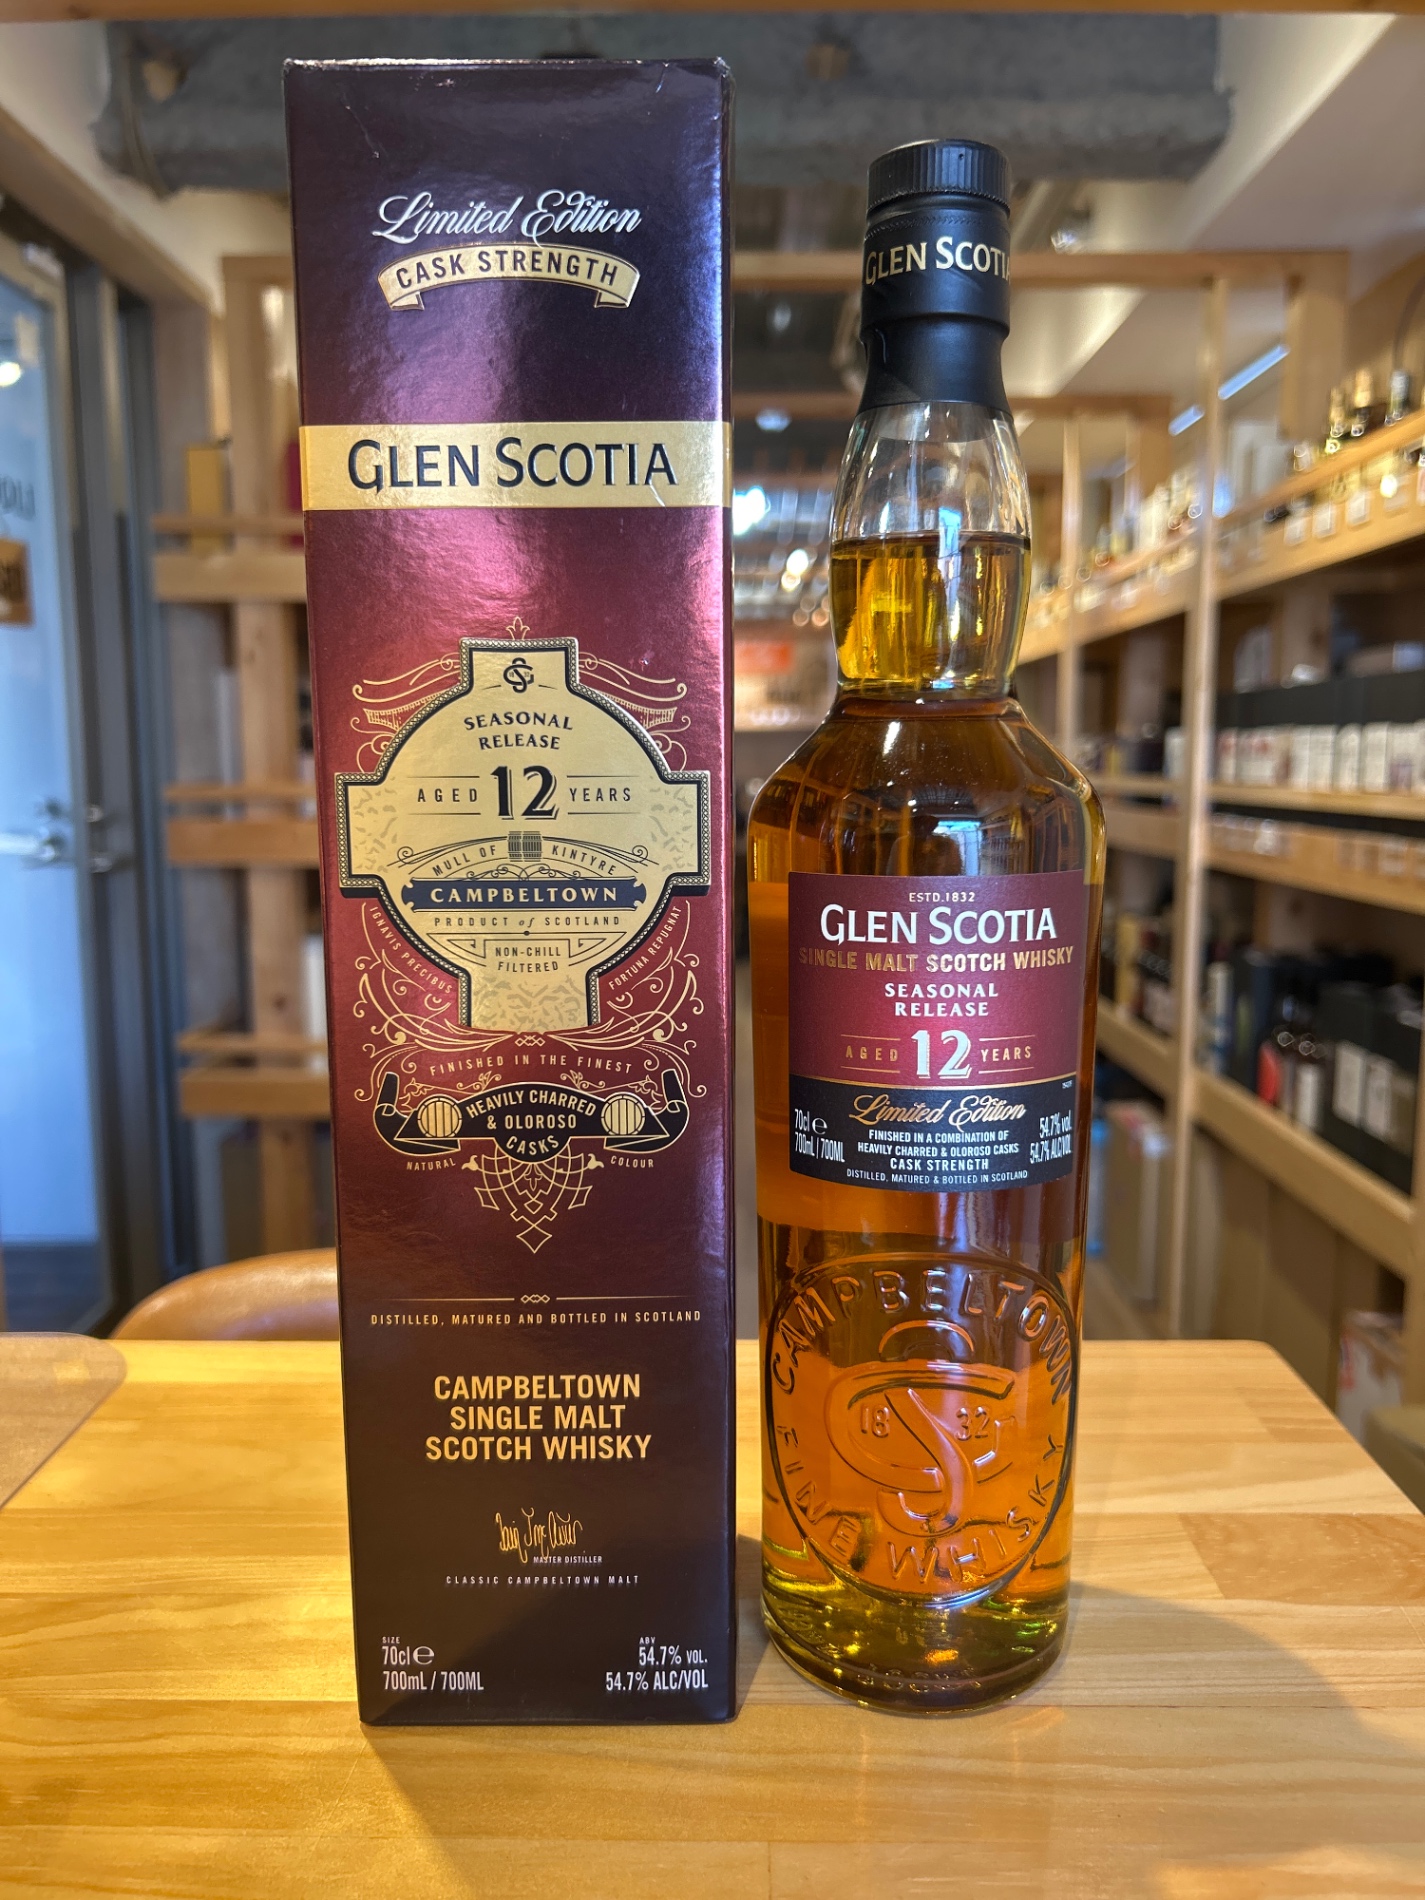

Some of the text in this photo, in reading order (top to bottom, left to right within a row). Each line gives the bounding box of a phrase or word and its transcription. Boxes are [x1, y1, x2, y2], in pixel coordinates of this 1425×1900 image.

[372, 189, 642, 248] Limited Edition
[396, 250, 618, 289] CASK STRENGTH
[348, 437, 678, 494] GLEN SCOTIA
[464, 712, 573, 730] SEASONAL
[479, 734, 560, 750] RELEASE
[418, 766, 631, 820] AGED 12 YEARS
[432, 845, 616, 876] MULL OF KINTYRE
[430, 887, 618, 903] CAMPBELTOWN
[434, 916, 620, 928] PRODUCT of SCOTLAND
[820, 904, 1057, 945] GLEN SCOTIA
[370, 906, 453, 994] IGNAVIS PRECIBUS
[495, 947, 561, 957] NON-CHILL
[608, 905, 682, 991] FORTUNA REPUGNAT
[498, 962, 559, 973] FILTERED
[799, 946, 1073, 973] SINGLE MALT SCOTCH WHISKY
[884, 982, 999, 998] SEASONAL
[894, 1002, 989, 1017] RELEASE
[429, 1054, 632, 1076] FINISHED IN THE FINEST
[845, 1030, 1031, 1079] AGED 12 YEARS
[465, 1089, 597, 1119] HEAVILY CHARRED
[849, 1094, 1027, 1132] Limited Edition
[486, 1114, 577, 1130] & OLOROSO
[505, 1135, 559, 1156] CASKS
[868, 1129, 1010, 1144] FINISHED IN A COMBINATION OF
[857, 1142, 1020, 1157] HEAVILY CHARRED & OLOROSO CASKS
[406, 1157, 457, 1171] NATURAL
[610, 1155, 655, 1168] COLOUR
[890, 1158, 989, 1171] CASK STRENGTH
[891, 1174, 930, 1184] MATURED
[933, 1175, 940, 1185] &
[942, 1174, 978, 1184] BOTTLED
[980, 1174, 989, 1183] IN
[991, 1169, 1028, 1182] SCOTLAND
[371, 1310, 701, 1326] DISTILLED, MATURED AND BOTTLED IN SCOTLAND
[773, 1269, 1071, 1406] CAMPBELTOWN
[434, 1373, 640, 1400] CAMPBELTOWN
[450, 1404, 626, 1430] SINGLE MALT
[860, 1405, 991, 1441] 18 32
[425, 1434, 652, 1460] SCOTCH WHISKY
[886, 1433, 1063, 1584] WHISKY
[533, 1555, 603, 1564] MASTER DISTILLER
[446, 1575, 639, 1585] CLASSIC CAMPBELTOWN MALT
[382, 1636, 400, 1644] SIZE
[639, 1636, 656, 1644] ABV
[638, 1645, 708, 1666] 54.7% VOL.
[383, 1670, 428, 1691] 700mL
[440, 1671, 485, 1691] 700ML
[606, 1668, 709, 1691] 54.7% ALC/VOL
